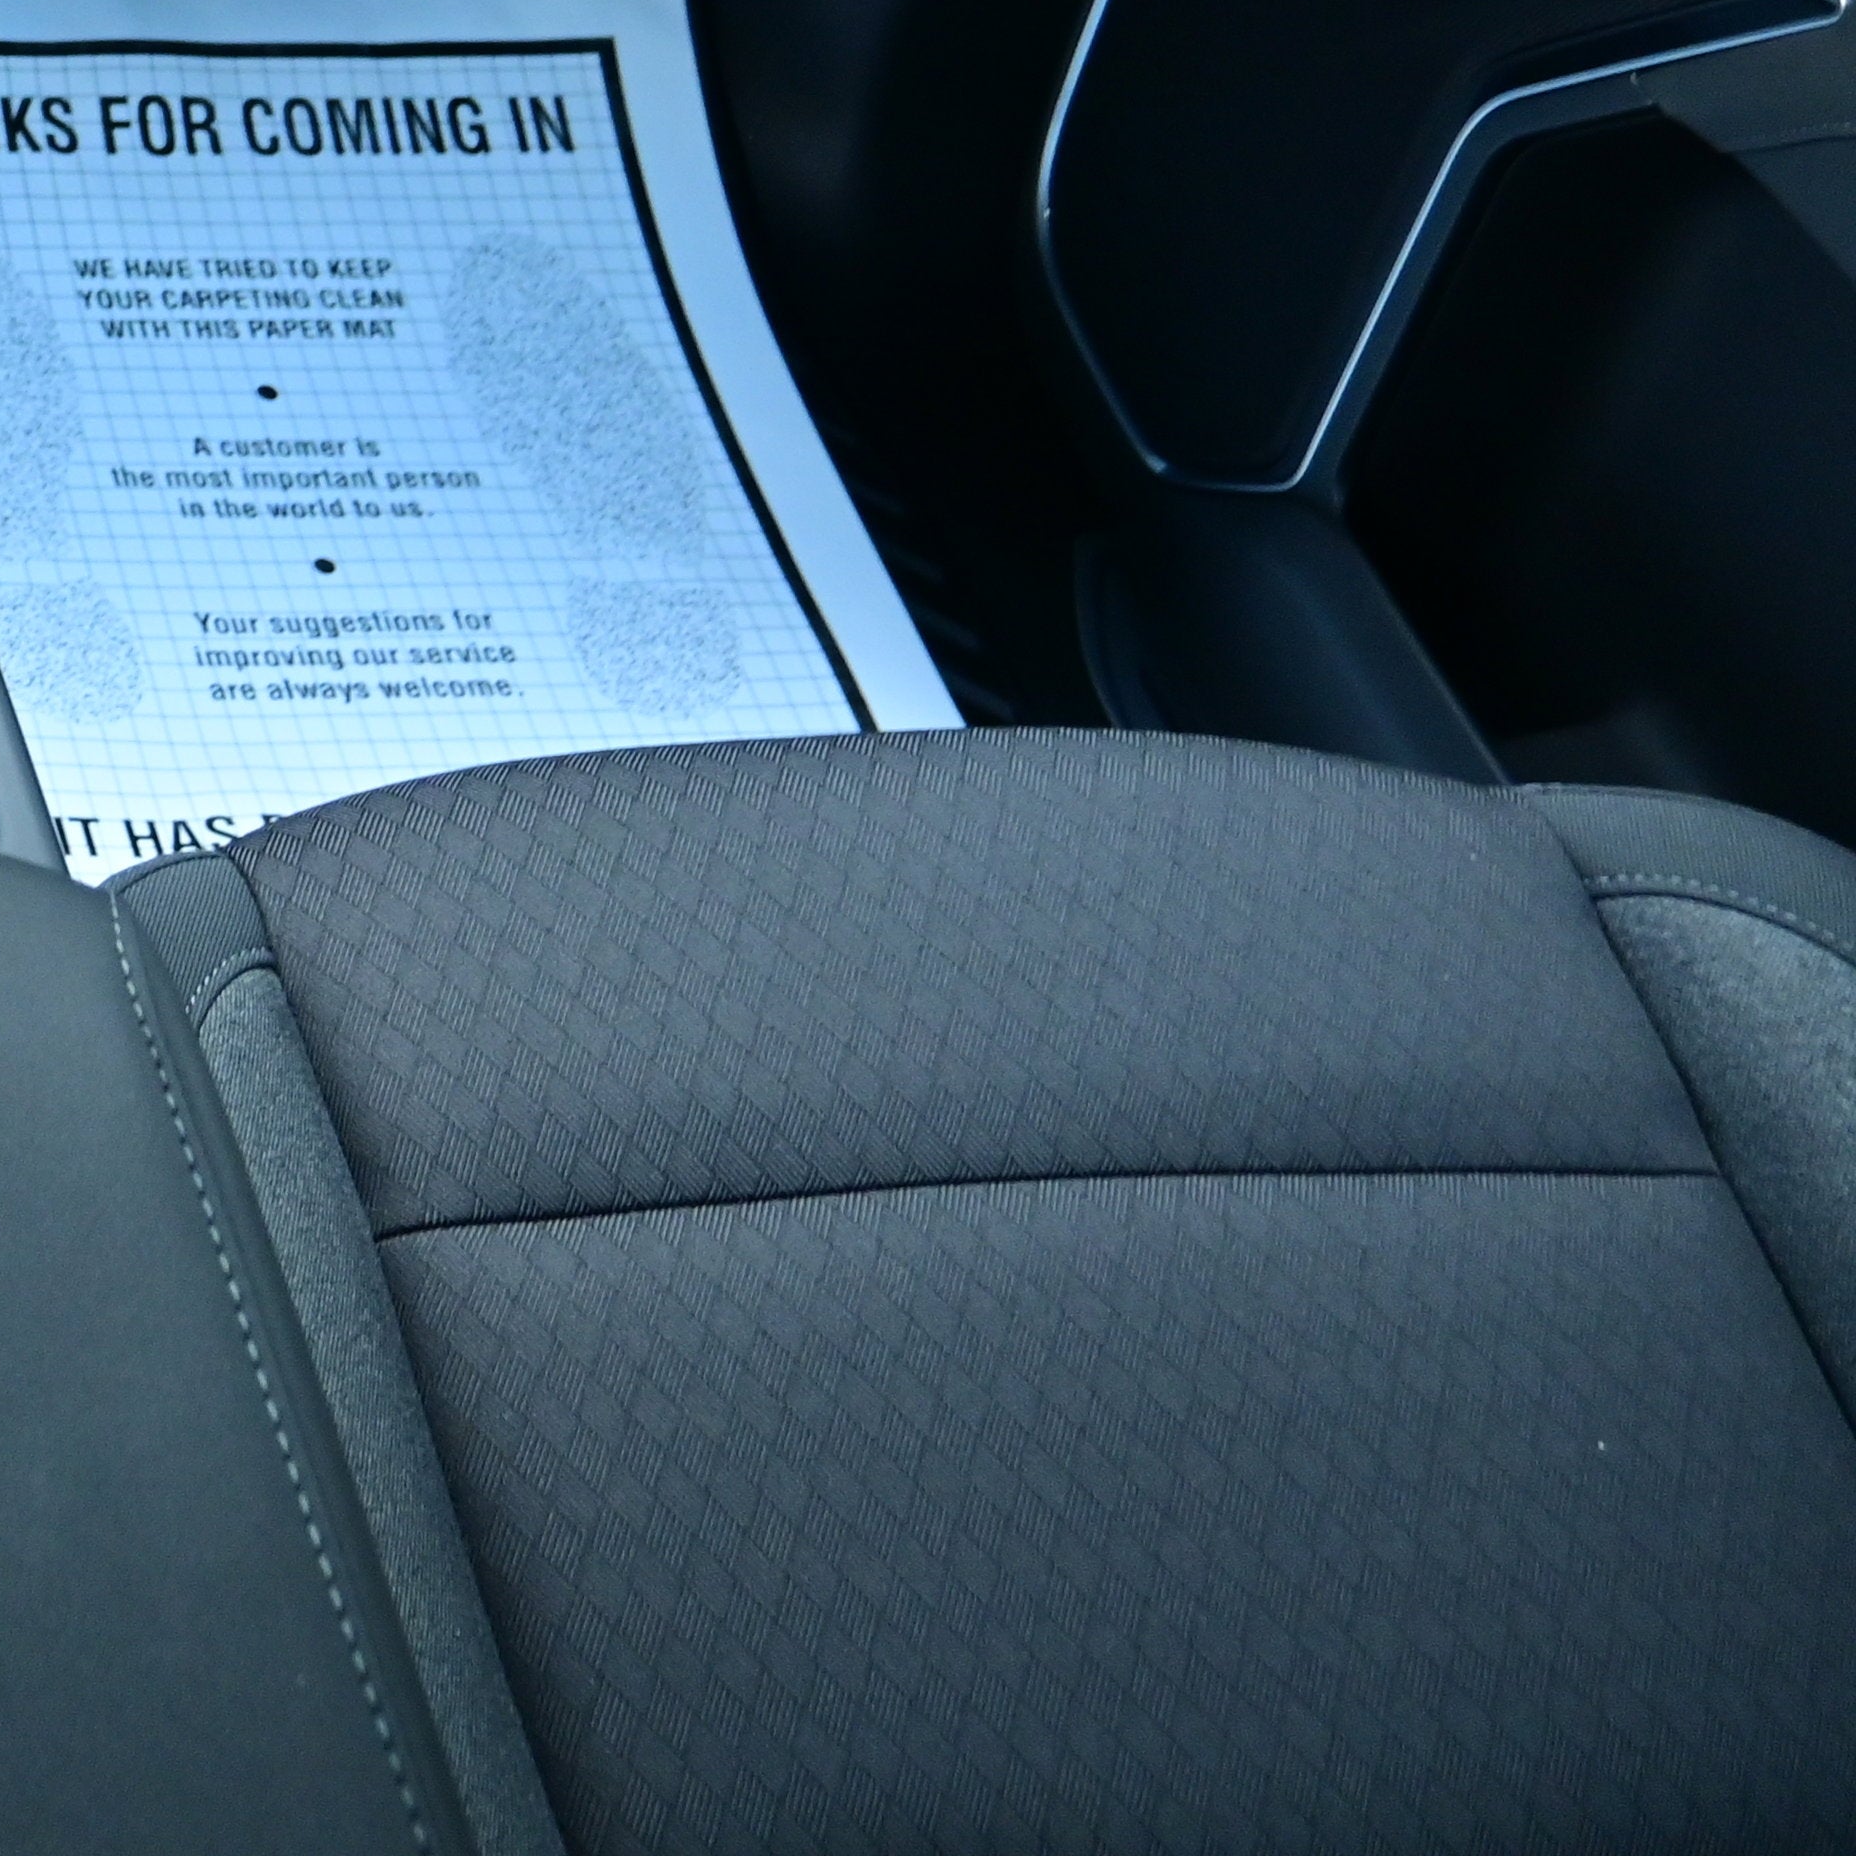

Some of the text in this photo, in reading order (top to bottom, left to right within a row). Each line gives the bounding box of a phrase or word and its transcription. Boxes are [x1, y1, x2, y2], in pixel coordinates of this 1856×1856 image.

[99, 94, 223, 156] FOR
[241, 95, 491, 156] COMING
[508, 96, 575, 153] IN
[73, 258, 392, 280] WE HAVE TRIED TO KEEP
[80, 288, 404, 310] YOUR CARPETING CLEAN
[100, 318, 396, 340] WITH THIS PAPER MAT
[192, 436, 381, 458] A customer is
[111, 467, 481, 491] the most important person
[178, 498, 436, 519] in the world to us.
[193, 609, 493, 638] Your suggestions for
[194, 643, 516, 672] improving our service
[209, 676, 524, 704] are always welcome.
[54, 816, 99, 857] IT
[123, 815, 238, 858] HAS
